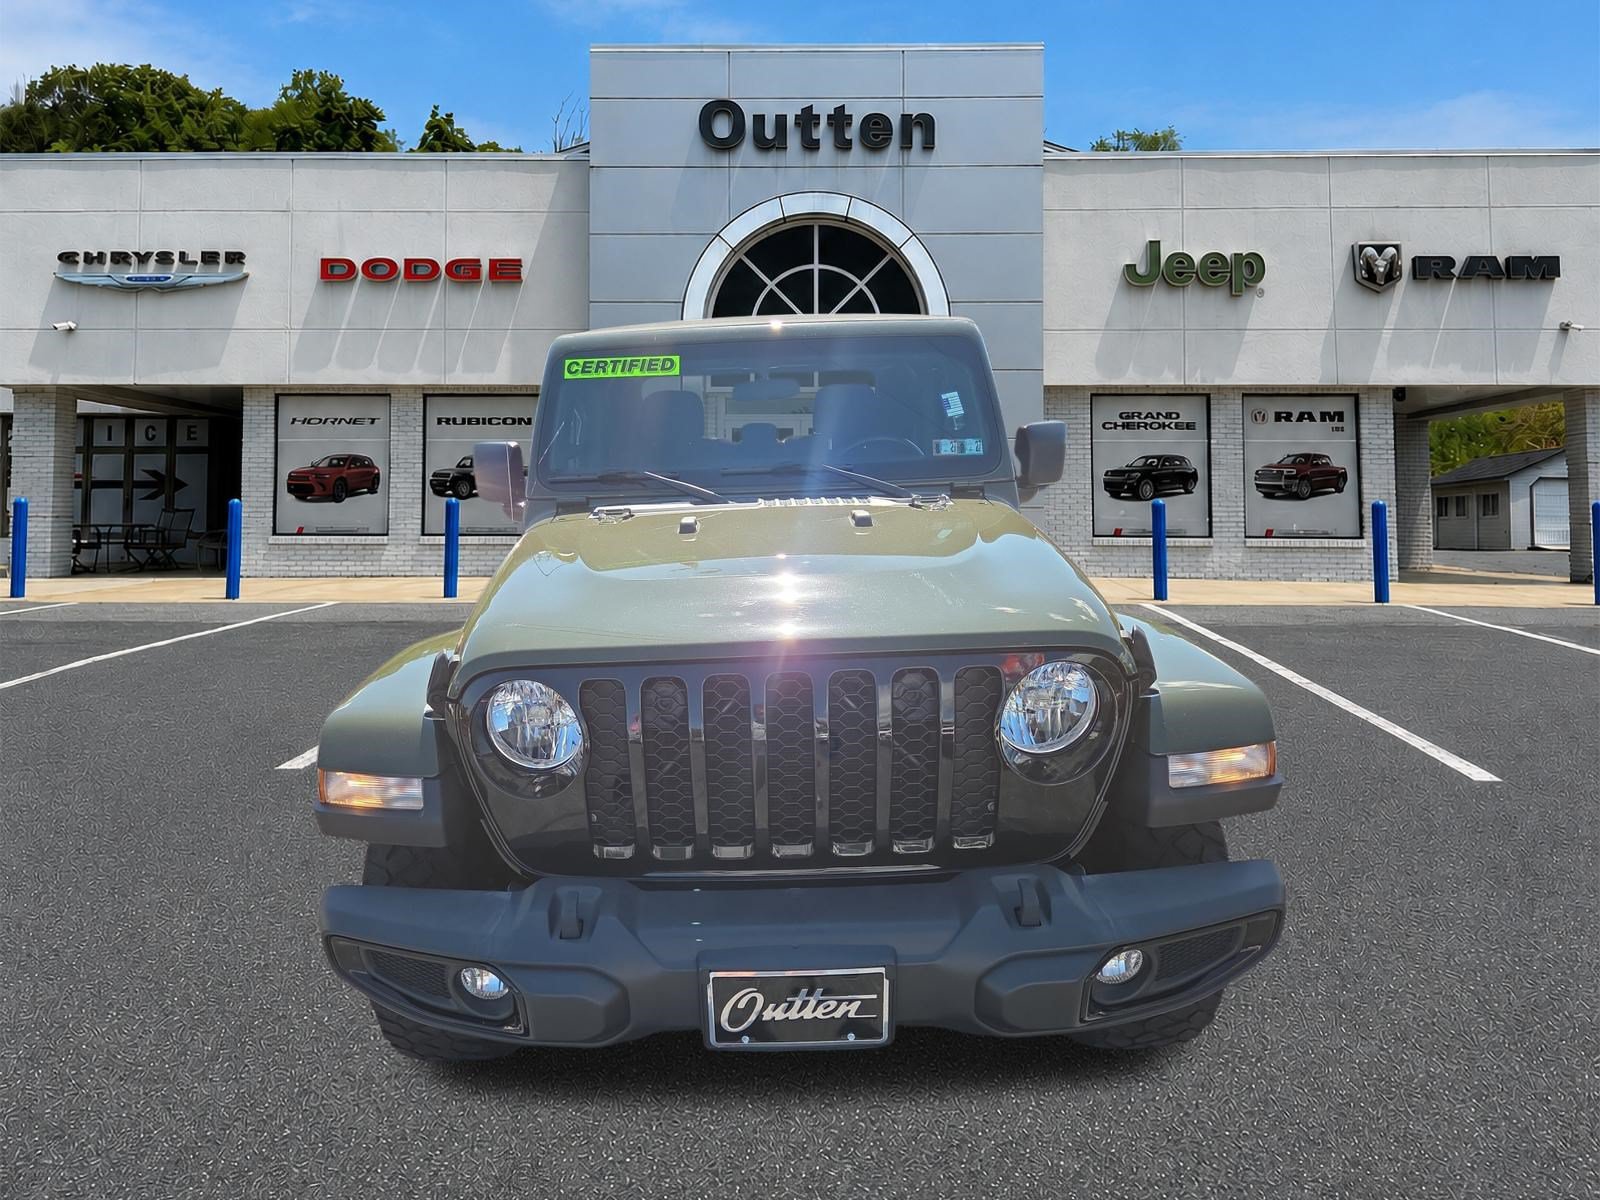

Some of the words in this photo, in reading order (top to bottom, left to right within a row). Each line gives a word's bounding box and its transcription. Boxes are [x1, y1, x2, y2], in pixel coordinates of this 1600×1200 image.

[699, 99, 936, 150] Outten
[57, 251, 247, 266] CHRYSLER
[320, 257, 523, 283] DODGE
[1123, 240, 1266, 297] Jeep
[1412, 255, 1561, 280] RAM
[566, 357, 675, 375] CERTIFIED
[290, 417, 381, 426] HORNET
[437, 417, 532, 426] RUBICON
[1119, 411, 1180, 420] GRAND
[1274, 411, 1344, 422] RAM
[1102, 421, 1196, 430] CHEROKEE
[720, 987, 878, 1033] Outten
